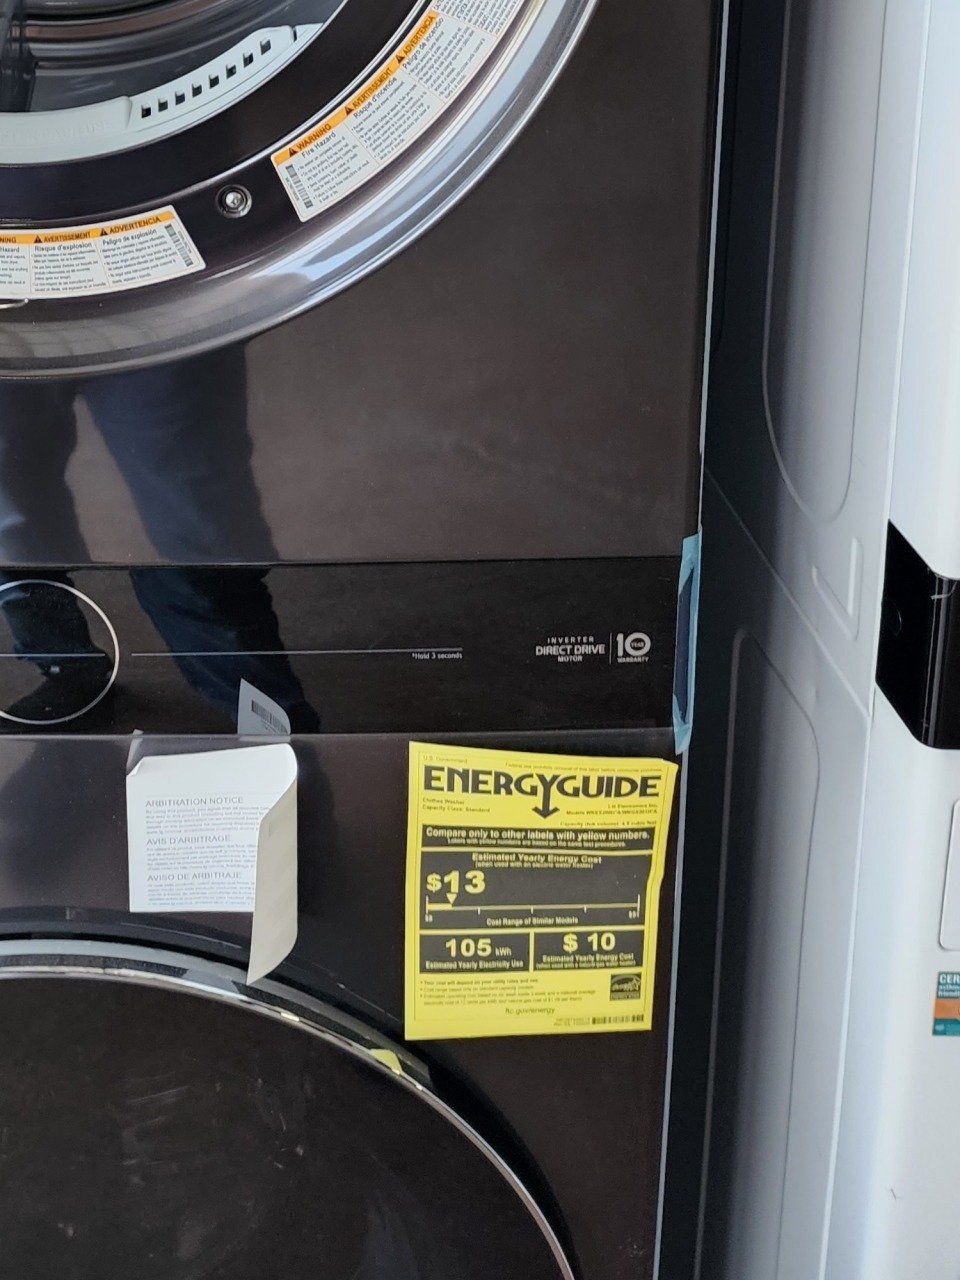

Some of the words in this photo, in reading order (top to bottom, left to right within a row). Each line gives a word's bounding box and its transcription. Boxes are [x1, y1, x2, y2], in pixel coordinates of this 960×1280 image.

[296, 123, 332, 151] WARNING
[109, 216, 162, 234] ADVERTENCIA
[547, 635, 594, 644] INVERTER
[616, 631, 652, 657] 10
[535, 644, 573, 656] DIRECT
[573, 643, 606, 655] DRIVE
[557, 655, 583, 663] MOTOR
[423, 765, 662, 801] ENERGYGUIDE
[145, 797, 207, 808] ARBITRATION
[209, 796, 244, 806] NOTICE
[146, 837, 167, 846] AVIS
[169, 834, 231, 845] D'ARBITRAGE
[426, 827, 466, 838] Compare
[468, 829, 489, 839] only
[490, 830, 500, 838] to
[501, 830, 526, 839] other
[527, 830, 555, 840] labels
[556, 831, 575, 840] with
[577, 831, 607, 841] yellow
[608, 830, 650, 840] numbers.
[471, 852, 516, 861] Estimated
[518, 854, 546, 863] Yearly
[547, 854, 579, 863] Energy
[580, 855, 602, 864] Cost
[146, 874, 175, 882] AVISO
[191, 871, 242, 880] ARBITRAJE
[426, 870, 486, 894] $13
[486, 917, 502, 926] Cost
[502, 917, 523, 927] Range
[524, 917, 531, 925] of
[445, 938, 492, 958] 105
[495, 947, 512, 957] kWh
[587, 932, 616, 952] 10
[542, 954, 574, 962] Estimated
[575, 954, 595, 962] Yearly
[425, 961, 457, 969] Estimated
[458, 961, 478, 970] Yearly
[511, 959, 524, 968] Use
